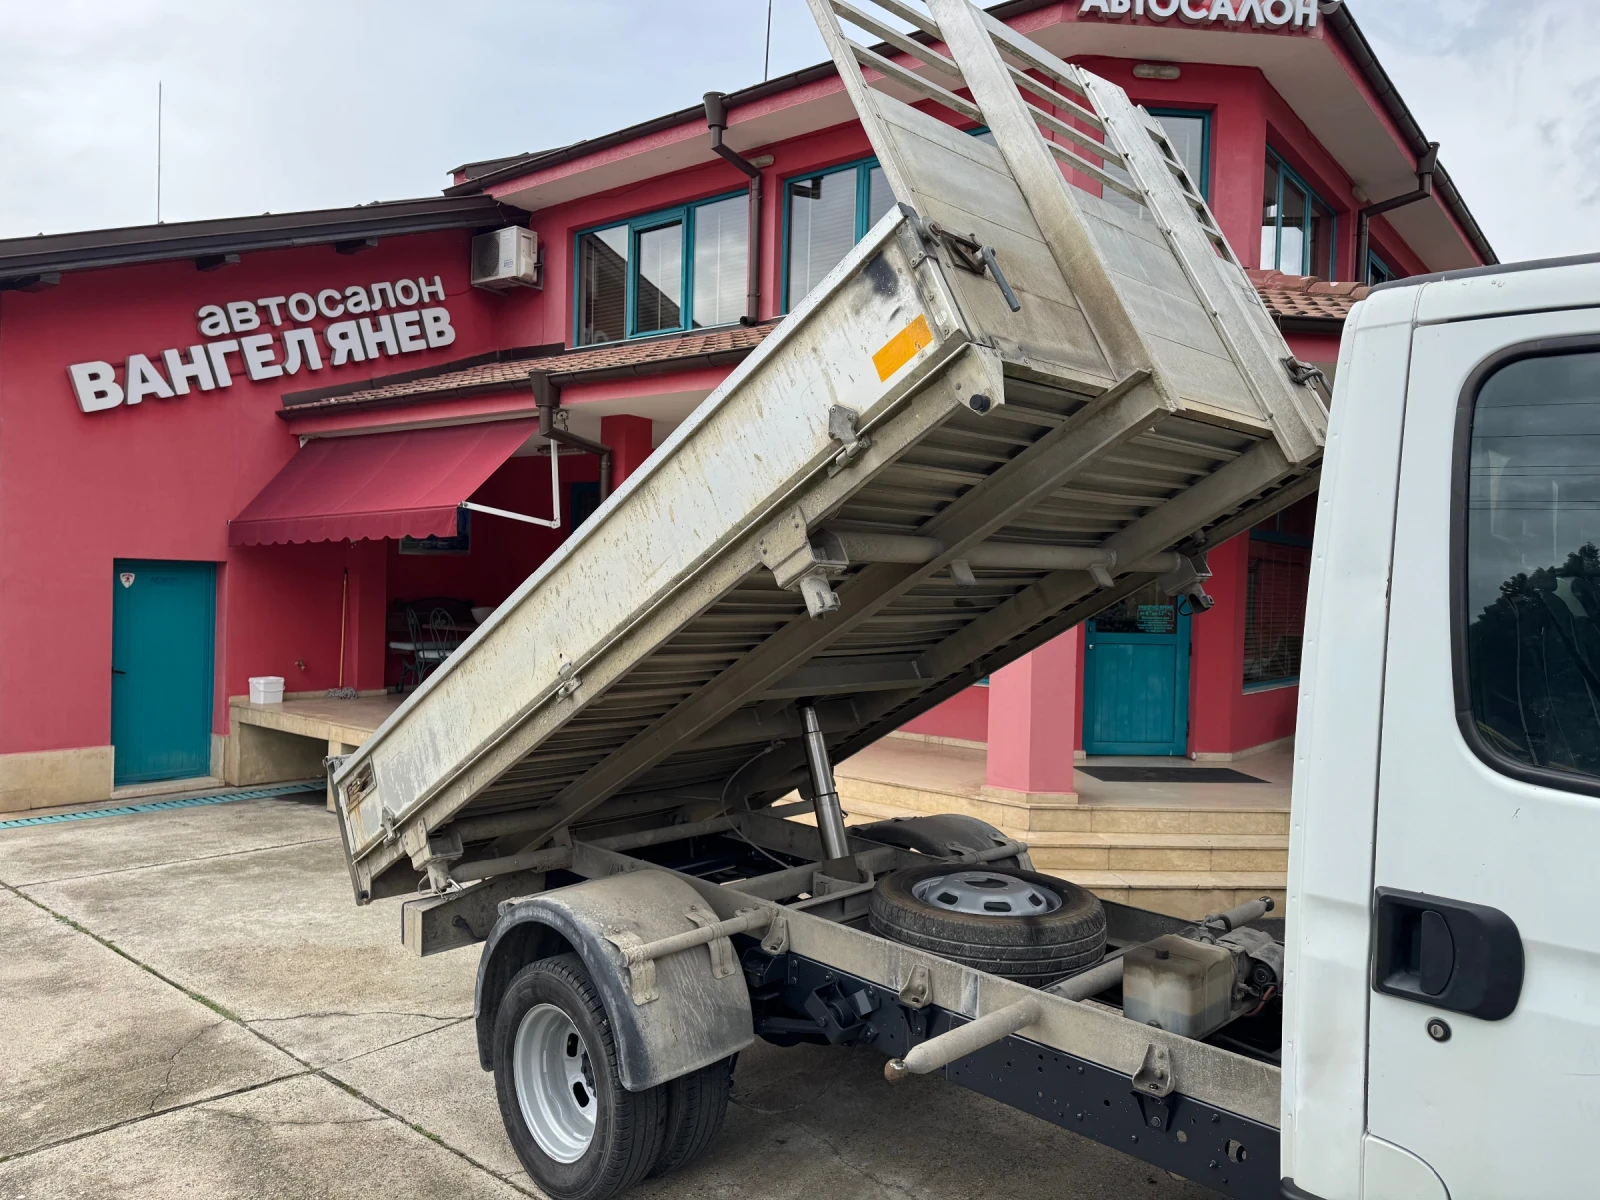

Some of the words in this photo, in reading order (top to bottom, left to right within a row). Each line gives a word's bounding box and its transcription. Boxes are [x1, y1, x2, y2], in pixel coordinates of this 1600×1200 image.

[198, 275, 445, 337] автосалон
[68, 327, 323, 413] ВАНГЕЛ
[325, 306, 456, 367] ЯНЕВ
